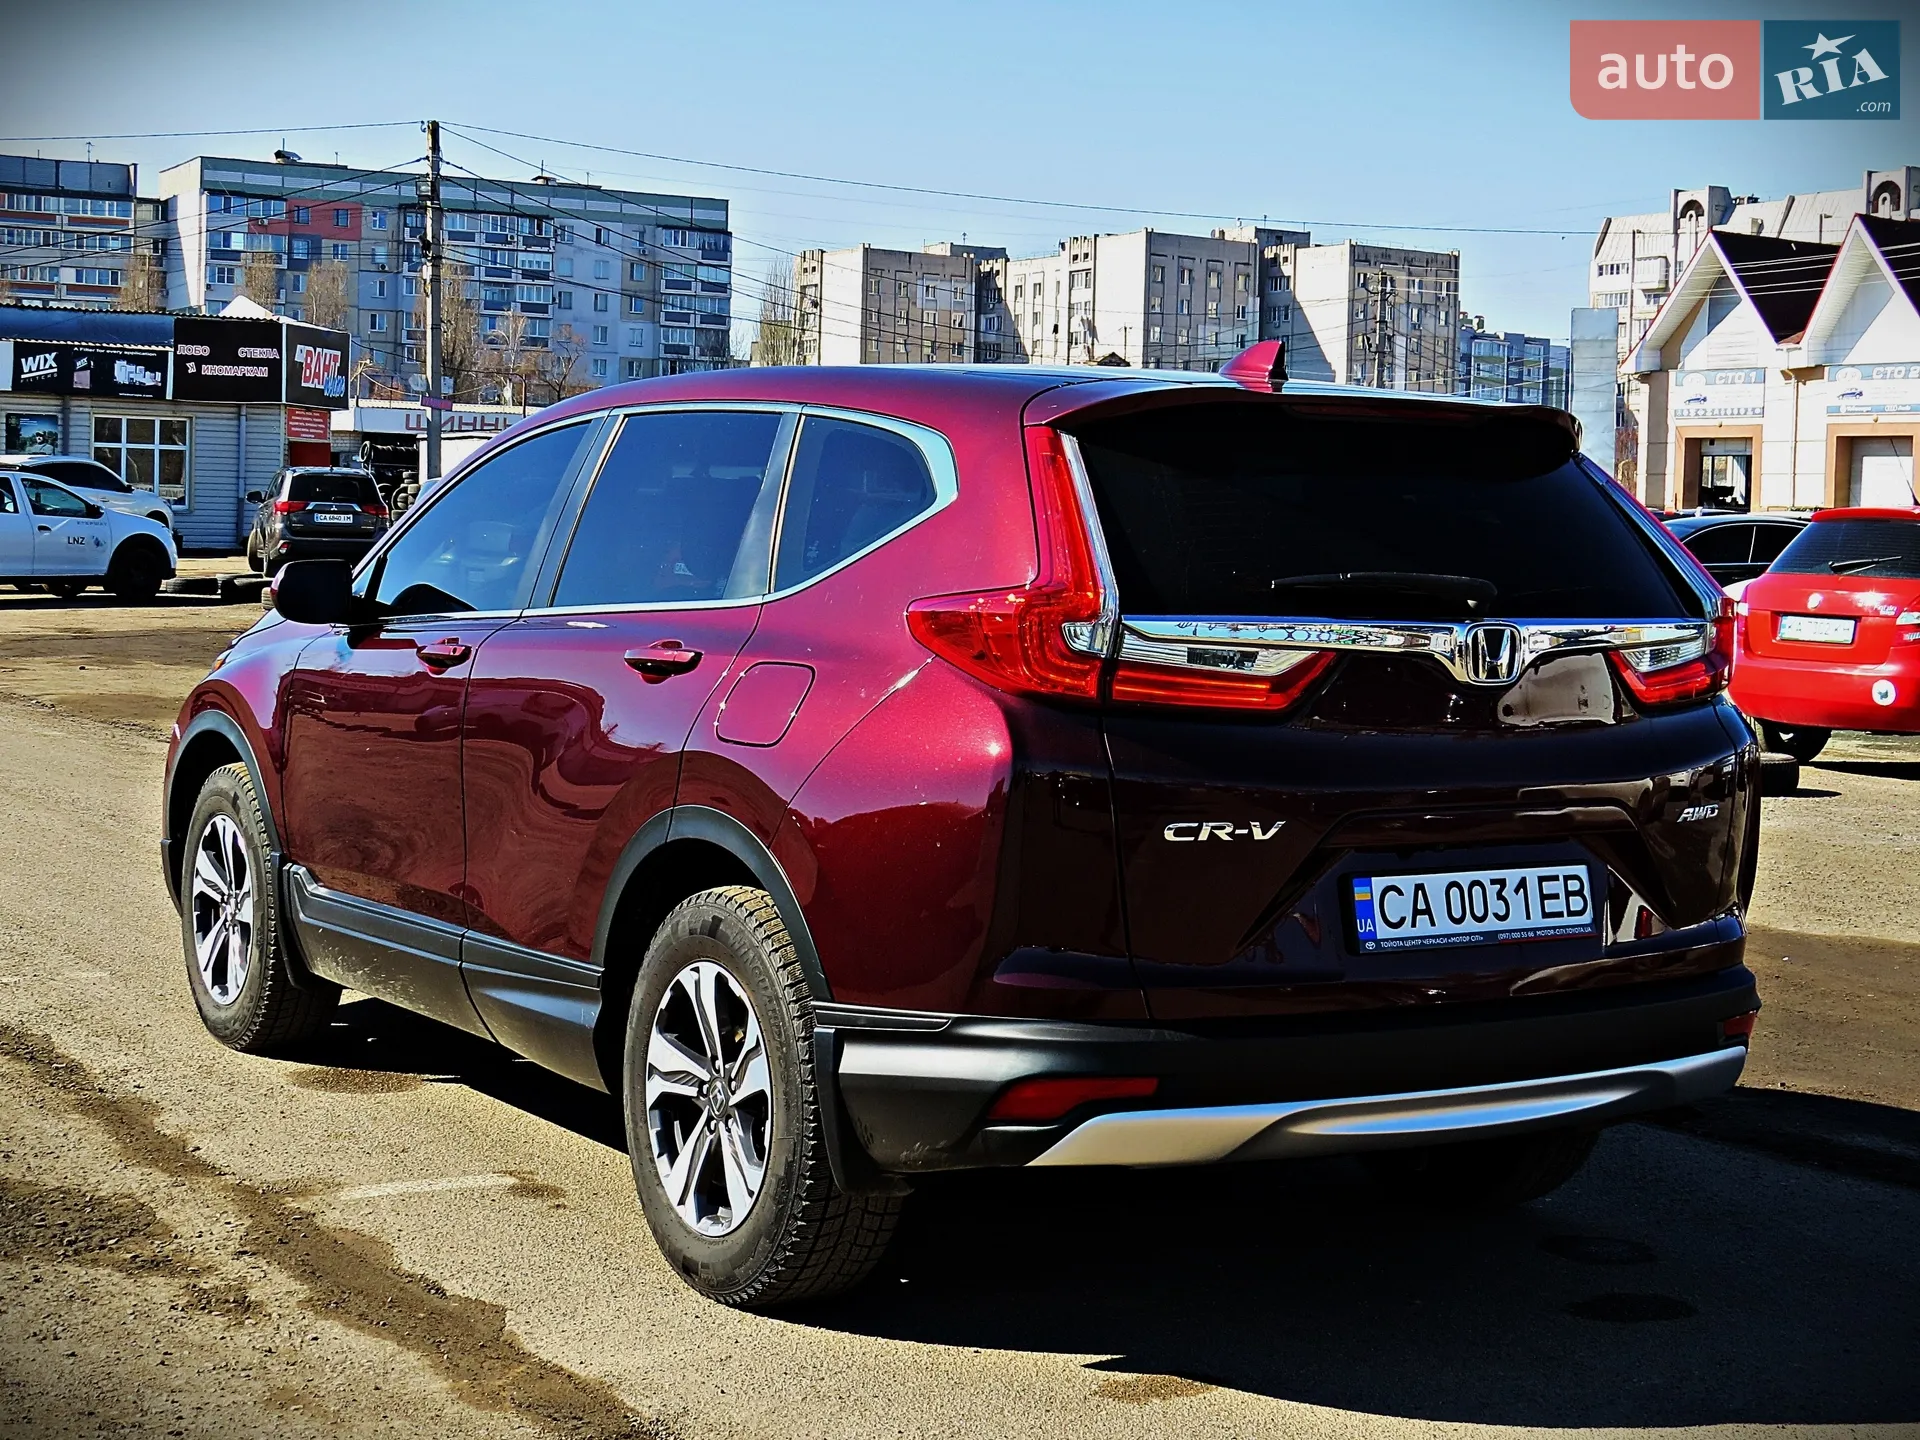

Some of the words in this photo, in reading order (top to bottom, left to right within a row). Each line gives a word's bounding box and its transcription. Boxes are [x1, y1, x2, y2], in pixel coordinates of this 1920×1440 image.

[176, 344, 211, 356] ЛОБО
[238, 347, 280, 359] СТЕКЛА
[21, 351, 58, 373] WIX
[202, 364, 268, 377] ИНОМАРКАМ
[1715, 372, 1746, 384] СТО
[1749, 371, 1757, 384] 1
[1872, 366, 1906, 379] СТО
[1908, 365, 1920, 378] 2
[20, 373, 58, 383] FILTERS
[67, 536, 86, 546] LNZ
[1676, 803, 1719, 823] AWD
[1163, 820, 1287, 842] CR-V
[1378, 882, 1437, 930] CA
[1444, 876, 1532, 926] 0031
[1536, 873, 1589, 920] EB
[1356, 917, 1375, 933] UA
[1380, 940, 1403, 948] ТОЙОТА
[1403, 939, 1421, 948] ЦЕНТР
[1422, 937, 1448, 946] ЧЕРКАСИ
[1497, 932, 1512, 941] (097)
[1511, 931, 1521, 939] 000
